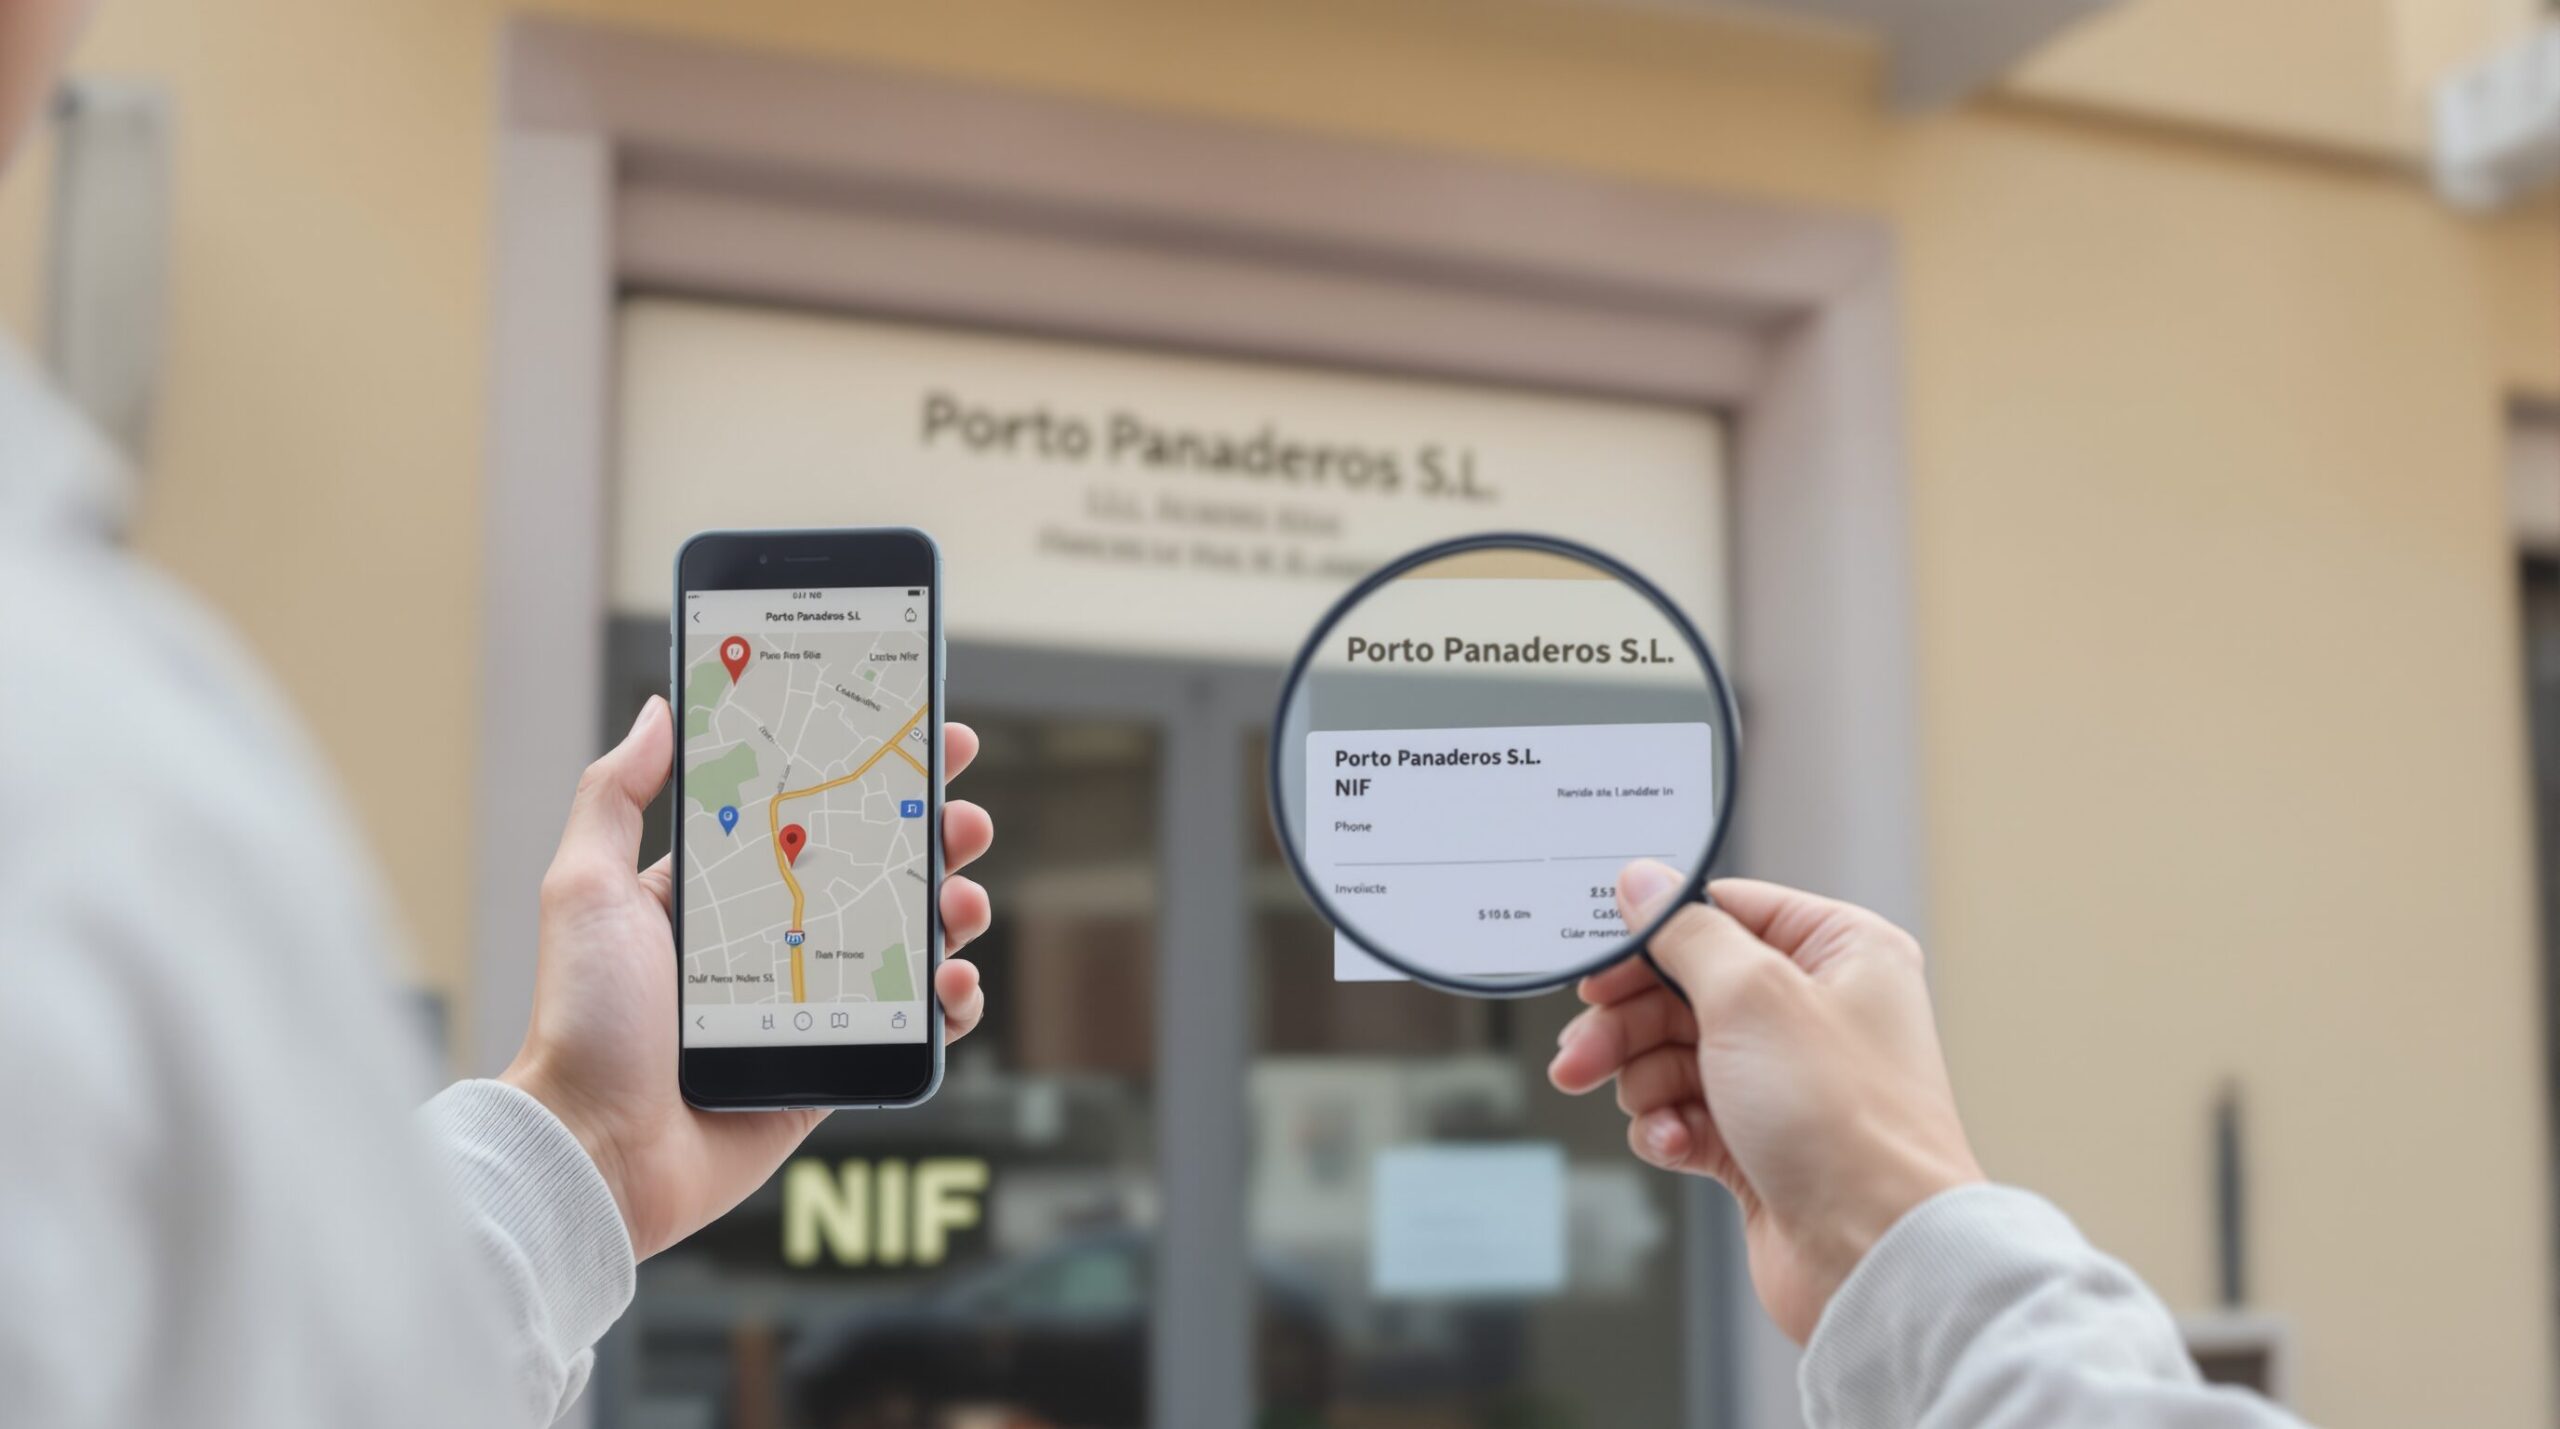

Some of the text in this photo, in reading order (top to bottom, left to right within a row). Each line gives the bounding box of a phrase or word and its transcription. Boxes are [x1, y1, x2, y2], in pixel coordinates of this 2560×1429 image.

[921, 392, 1498, 502] Porto Panaderos S.L.
[765, 611, 794, 622] Porto
[1347, 636, 1675, 664] Porto Panaderos S.L.
[1335, 748, 1541, 767] Porto Panaderos S.L.
[1335, 778, 1372, 796] NIF
[1335, 821, 1372, 832] Phone
[783, 1158, 989, 1266] NIF
